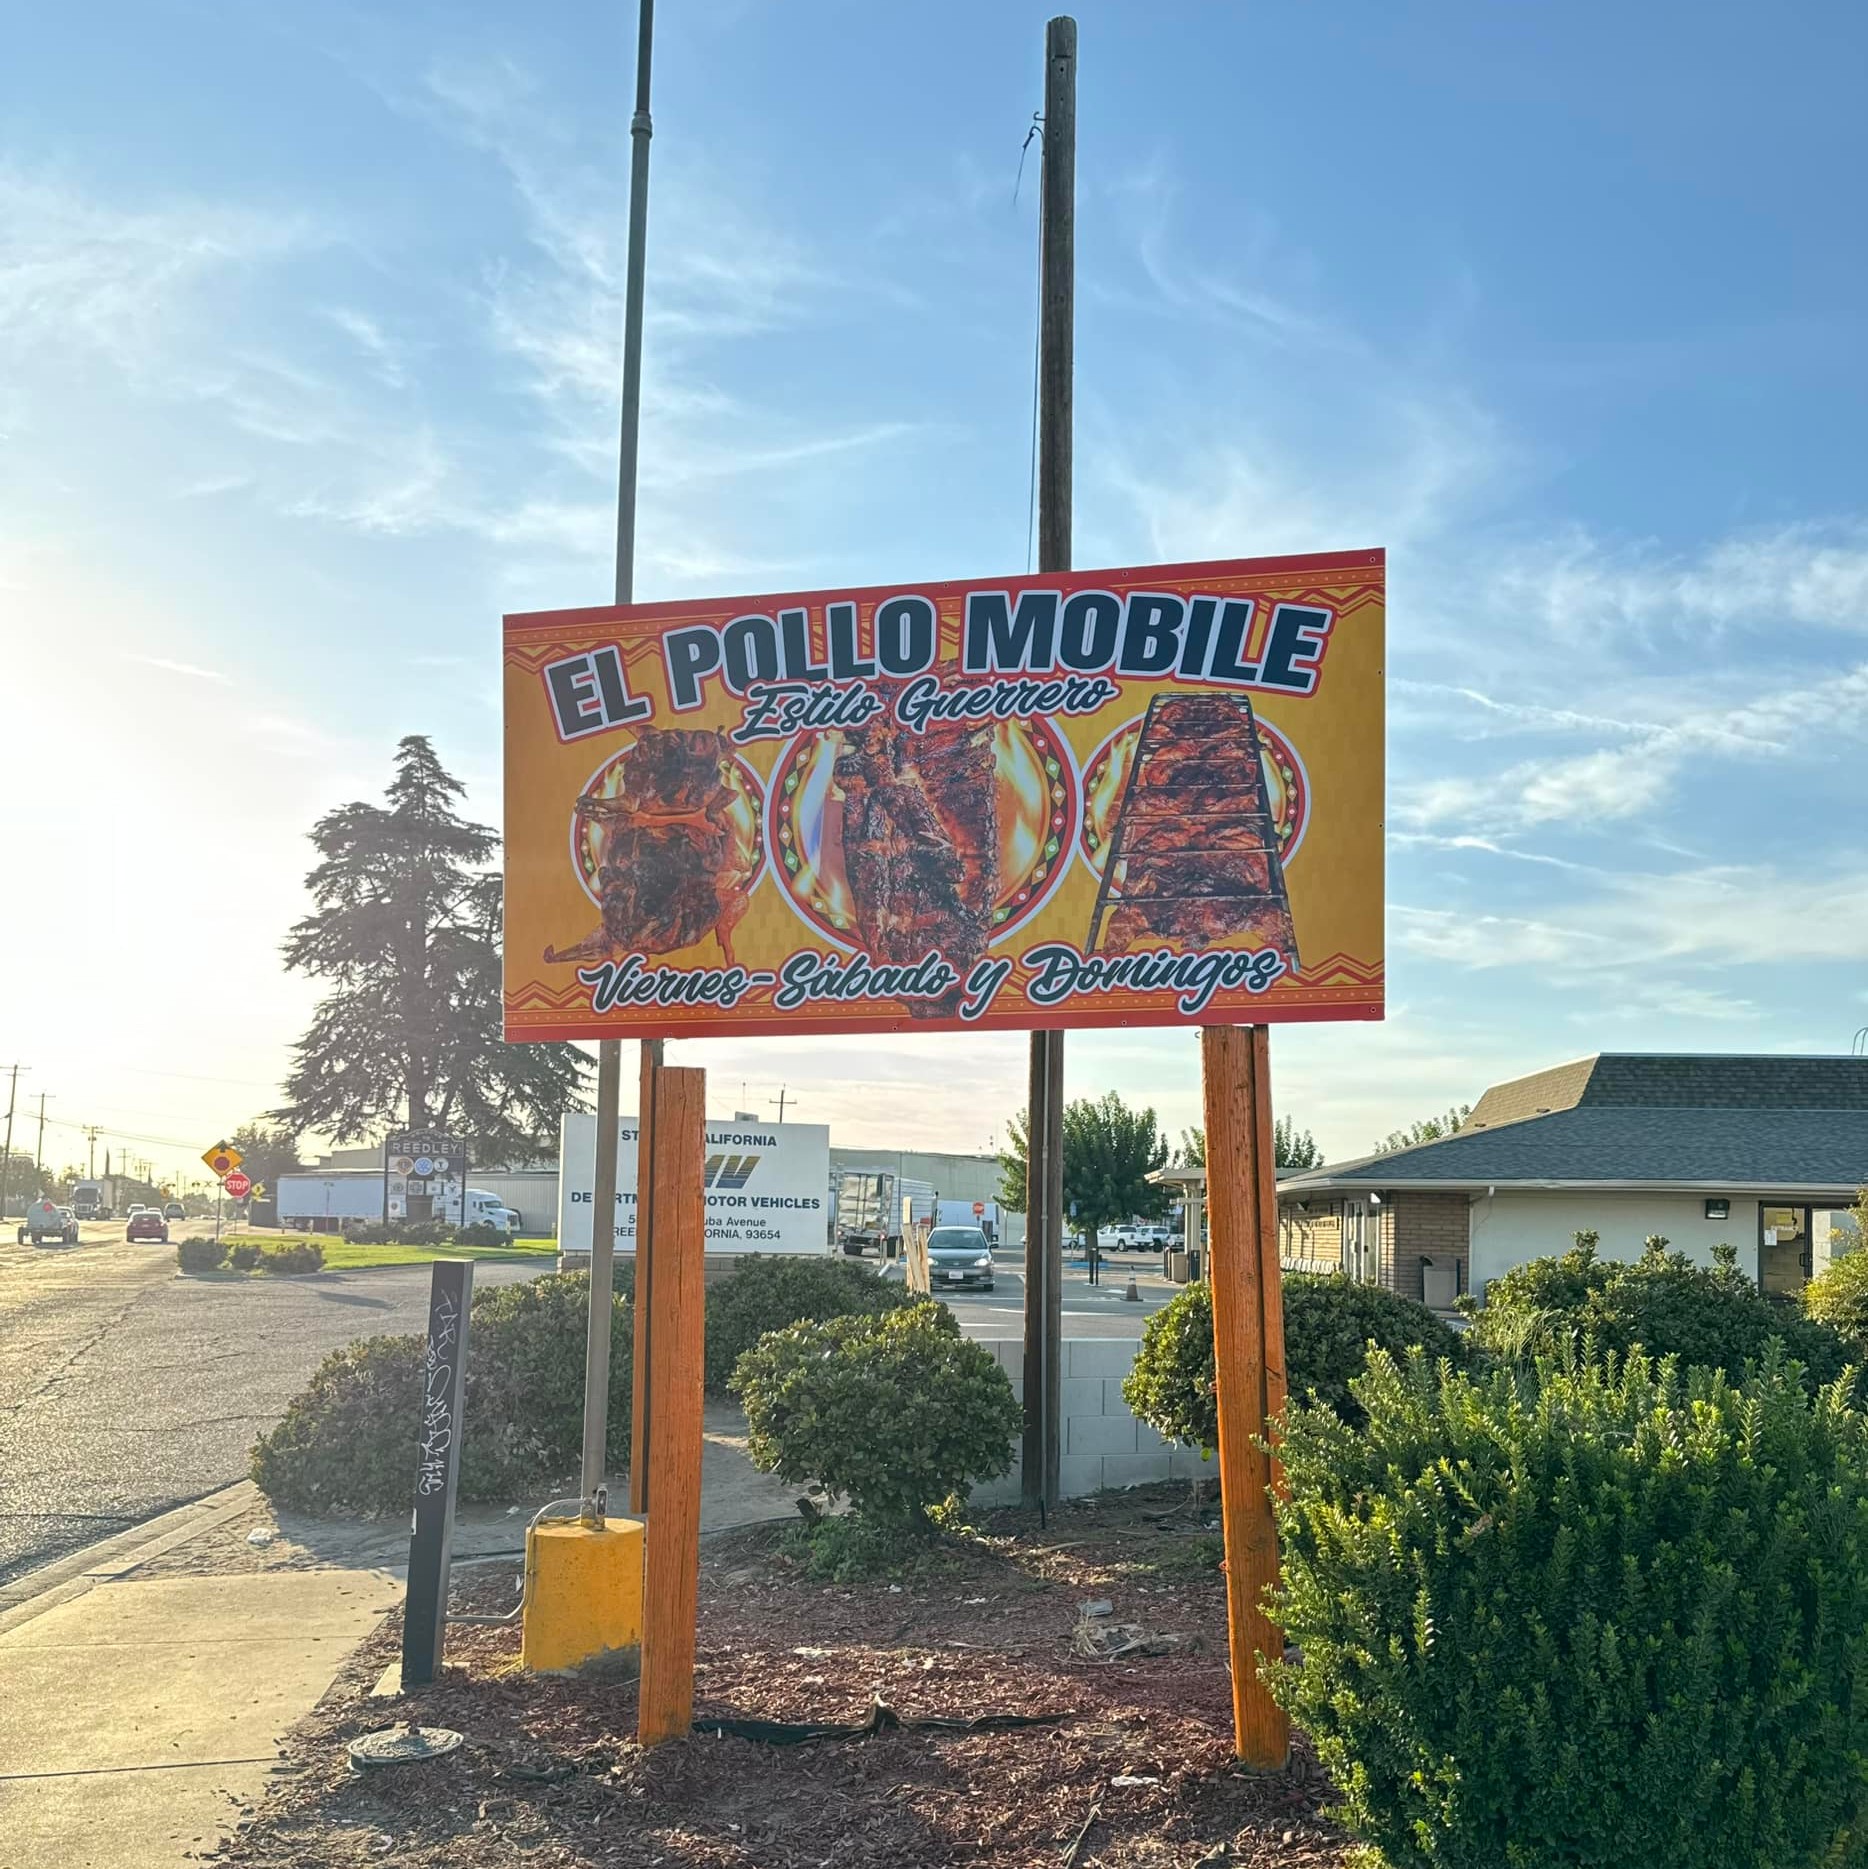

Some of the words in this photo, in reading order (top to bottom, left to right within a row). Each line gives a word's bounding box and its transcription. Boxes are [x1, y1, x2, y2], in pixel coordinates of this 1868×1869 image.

[546, 649, 649, 737] EL
[664, 597, 934, 706] POLLO
[965, 592, 1331, 689] MOBILE
[731, 683, 884, 742] Estilo
[900, 677, 1119, 732] Guerrero
[777, 951, 957, 1005] Sábado
[961, 957, 1009, 1018] y
[1025, 945, 1285, 1012] Domingos
[704, 1133, 777, 1147] ALIFORNIA
[392, 1143, 458, 1154] REEDLEY
[226, 1180, 249, 1190] STOP
[704, 1196, 748, 1208] OTOR
[751, 1196, 821, 1210] VEHICLES
[726, 1217, 767, 1227] Avenue
[745, 1230, 782, 1240] 93654
